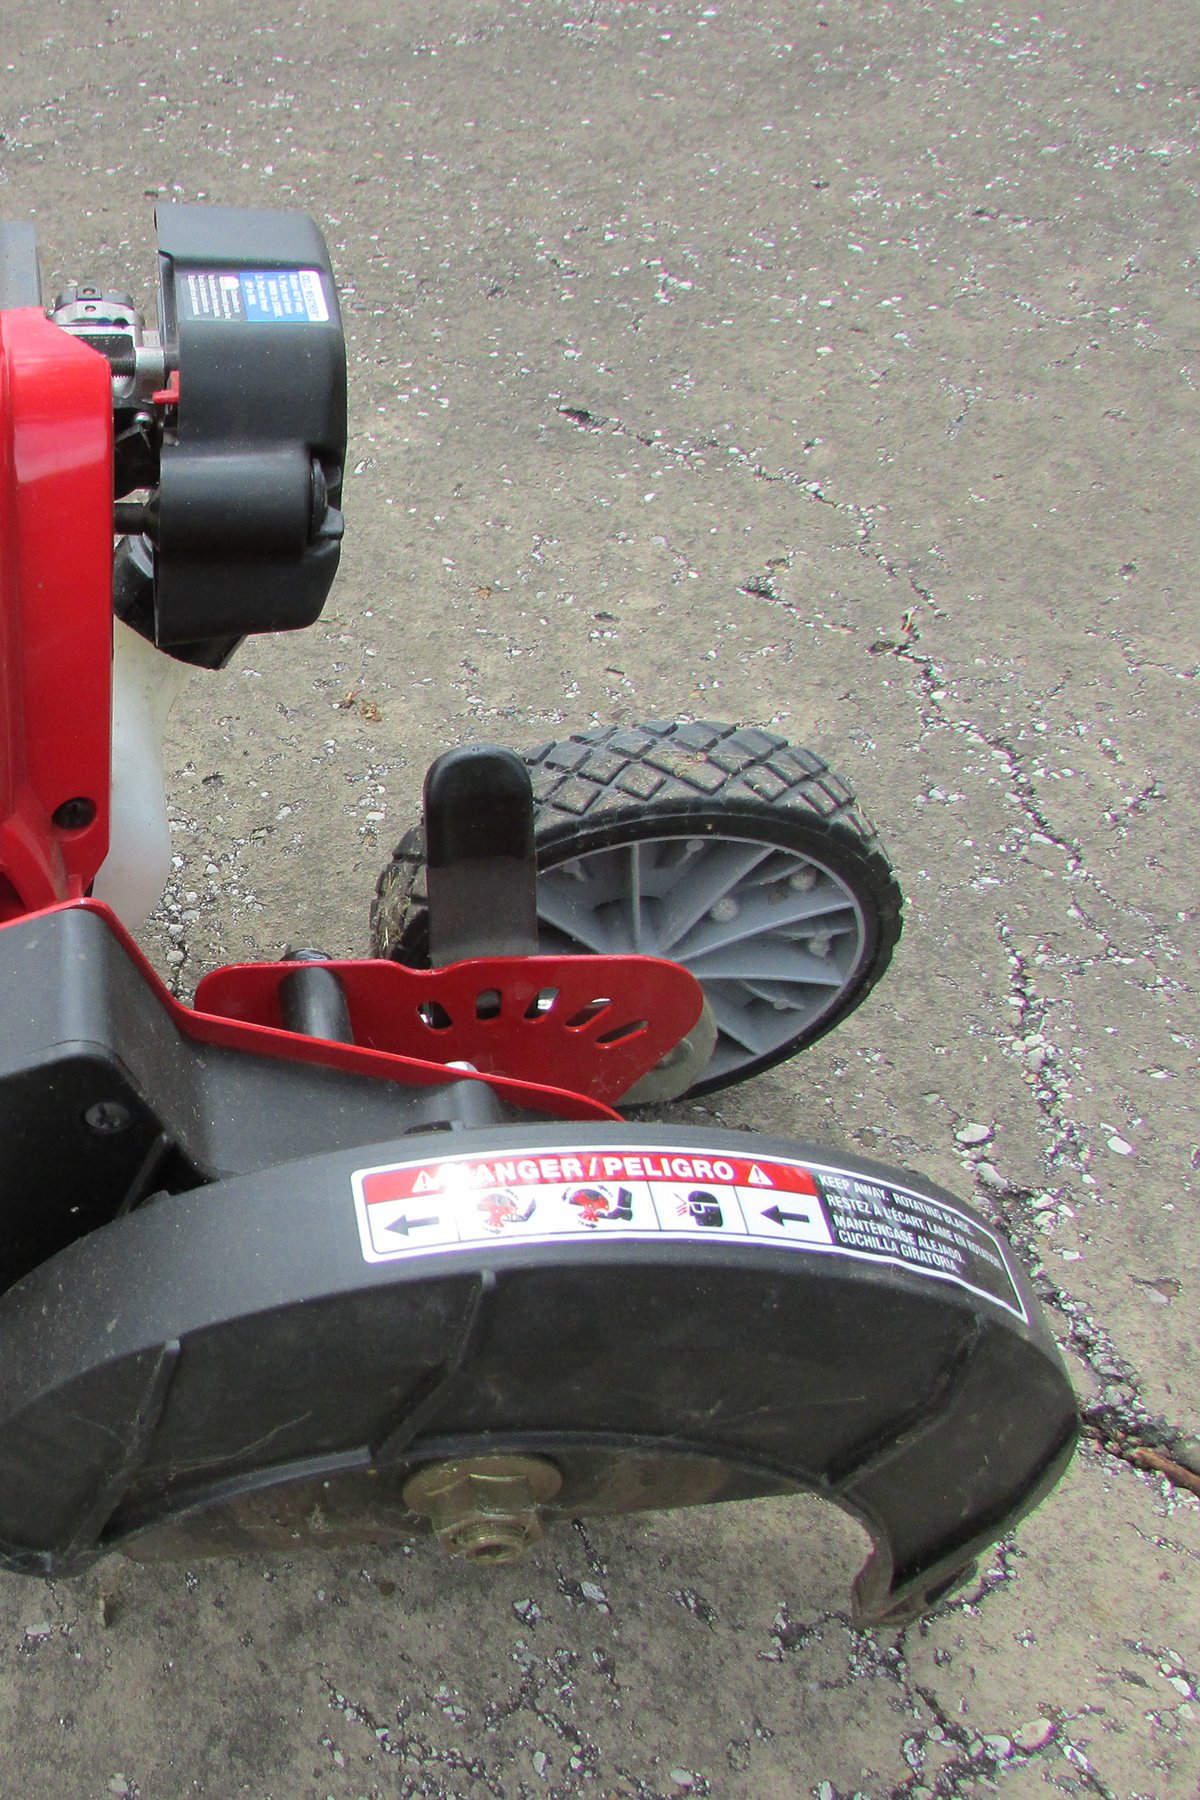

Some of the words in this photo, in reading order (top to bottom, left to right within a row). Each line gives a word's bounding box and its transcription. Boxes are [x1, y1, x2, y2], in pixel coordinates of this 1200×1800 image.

[448, 1158, 584, 1190] ANGER
[604, 1156, 735, 1181] PELIGRO
[818, 1174, 850, 1191] KEEP
[854, 1181, 890, 1201] AWAY.
[892, 1192, 942, 1221] ROTATING
[825, 1194, 872, 1215] RESTEZ
[832, 1213, 917, 1245] MANTÉNGASE
[838, 1229, 900, 1254] CUCHILLA
